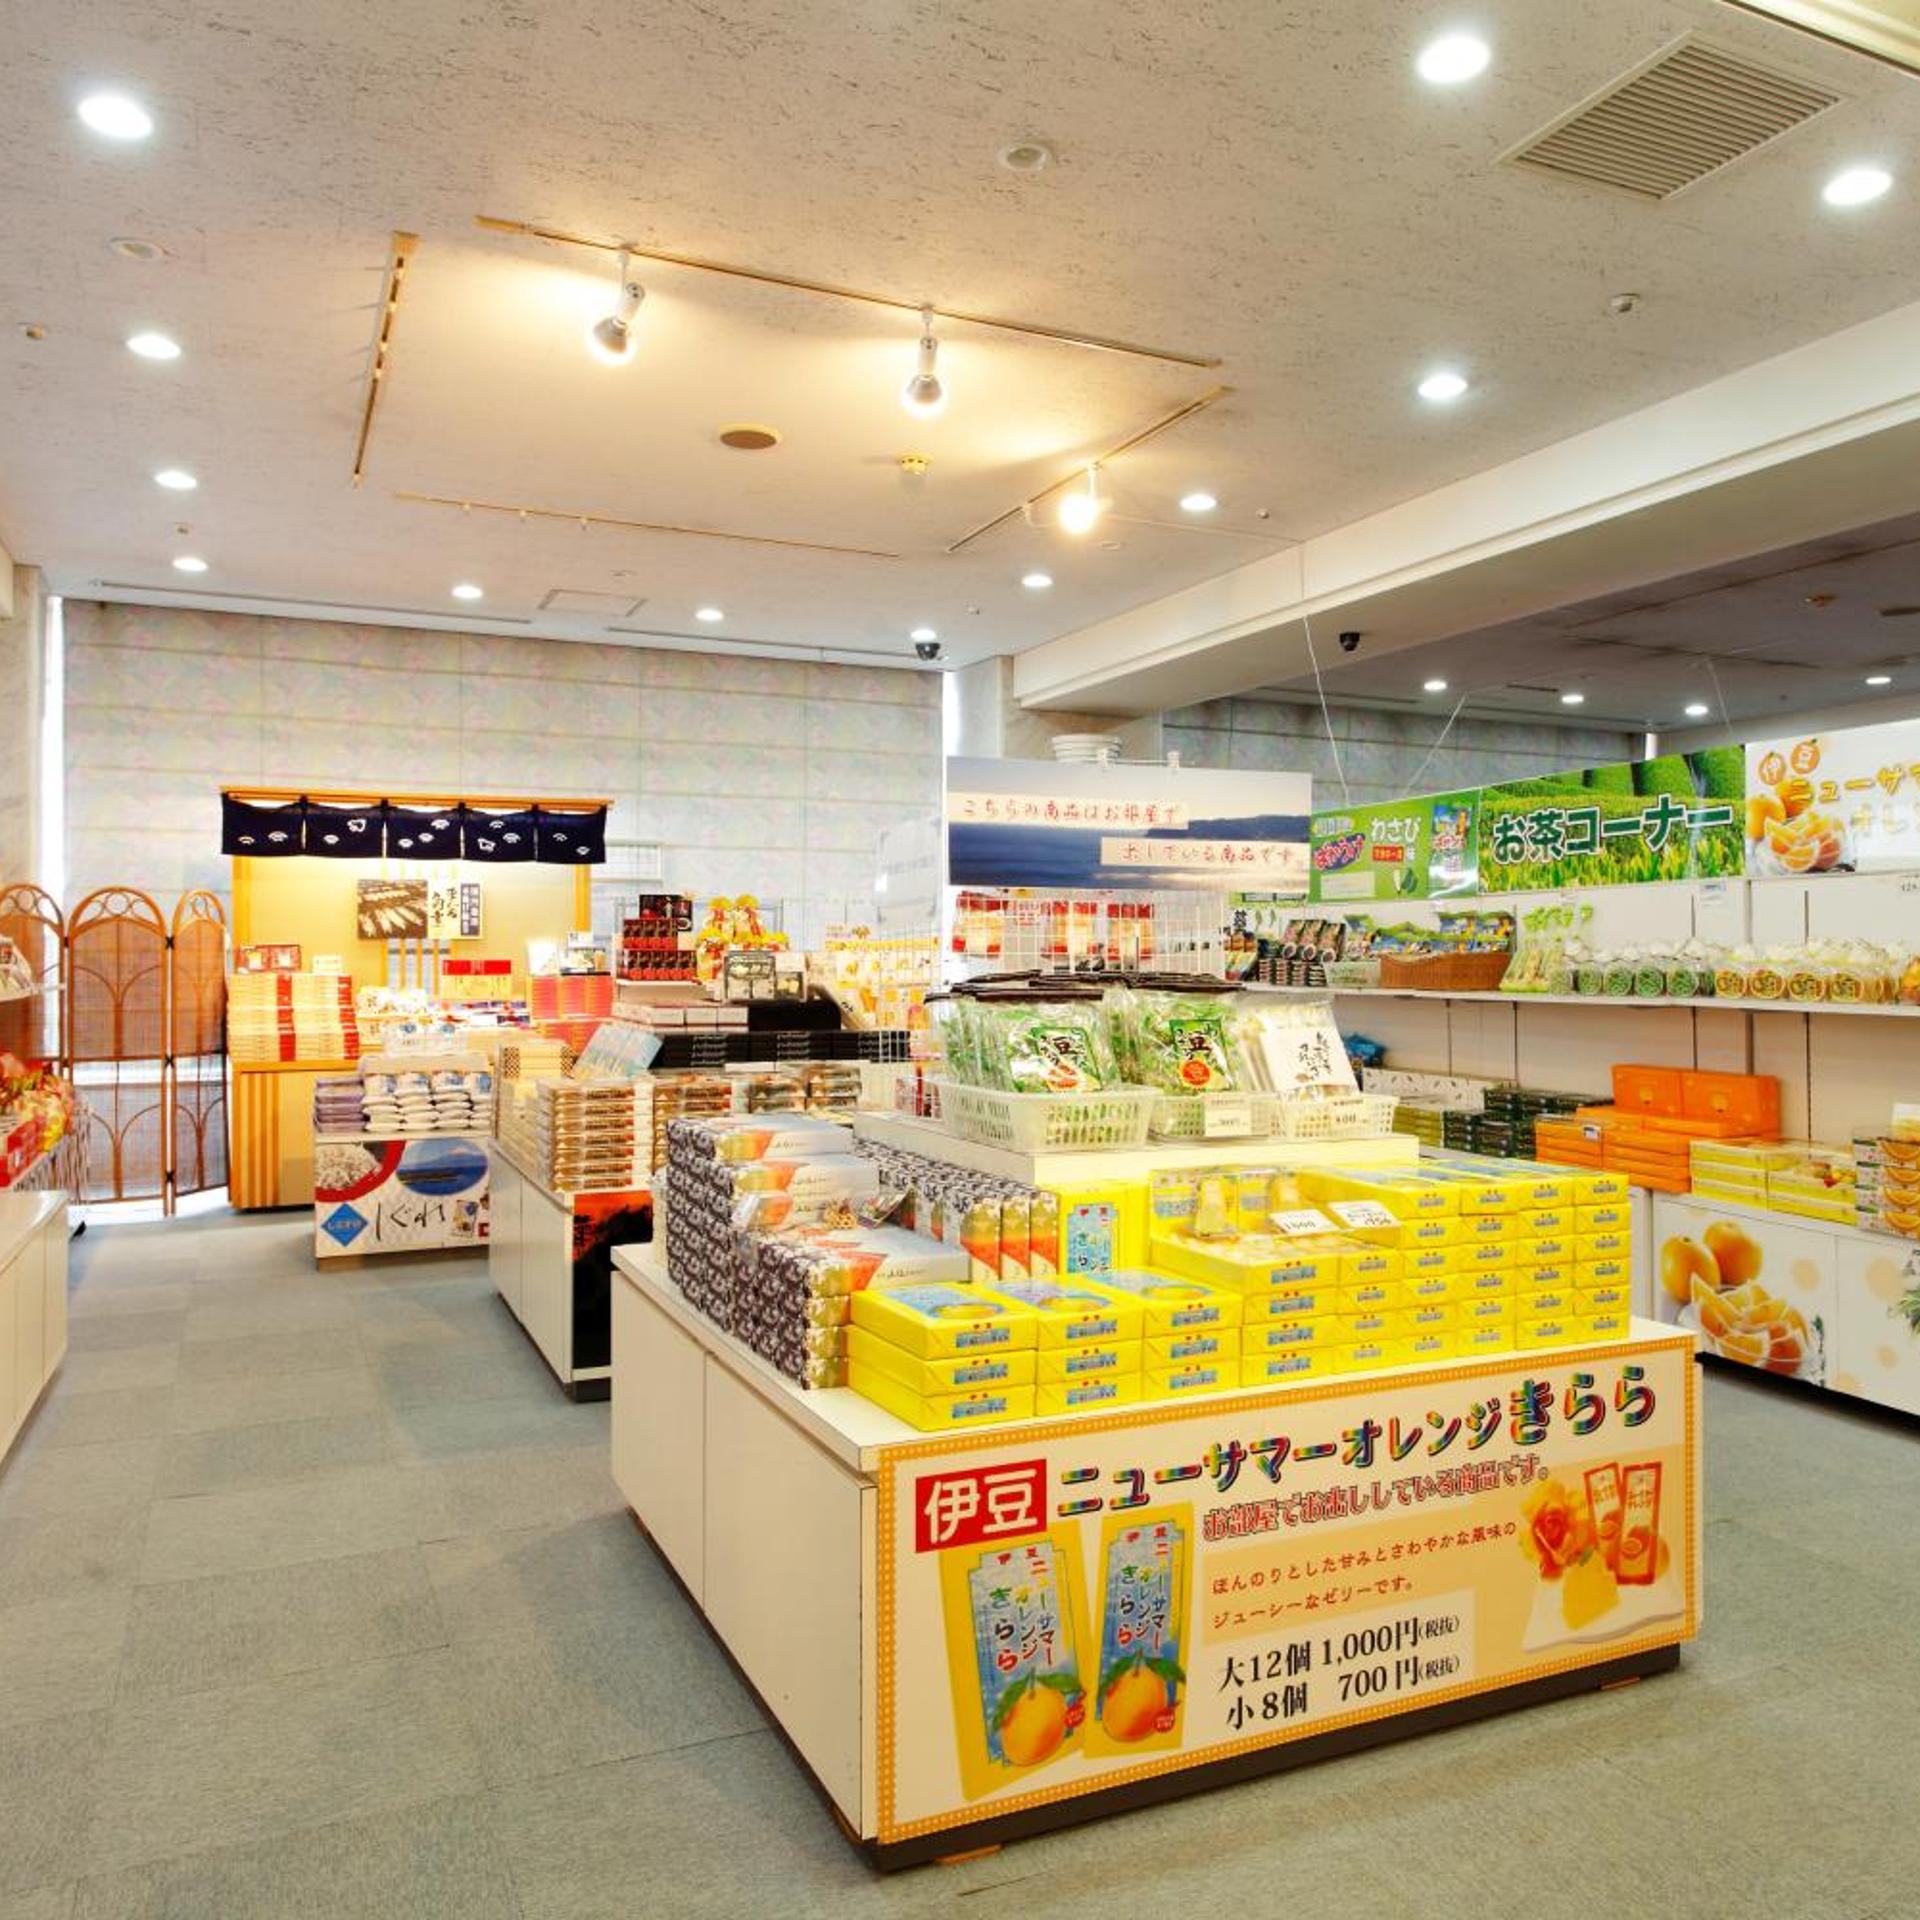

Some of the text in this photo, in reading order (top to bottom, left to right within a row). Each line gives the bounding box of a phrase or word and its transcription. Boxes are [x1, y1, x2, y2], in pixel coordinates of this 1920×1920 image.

[1371, 816, 1421, 843] わさび
[1493, 793, 1733, 864] お茶コーナー
[1057, 1365, 1657, 1517] ニューサマーオレンジきらら
[924, 1468, 1038, 1545] 伊豆
[1203, 1454, 1549, 1542] お部屋でお出ししている商品です。
[1213, 1521, 1517, 1595] ほんのりとした甘みとさわやかな風味の
[989, 1586, 1018, 1672] きらら
[1117, 1564, 1140, 1645] きらら
[1213, 1576, 1413, 1630] ジューシーなゼリーです。
[1218, 1640, 1311, 1693] 大12個
